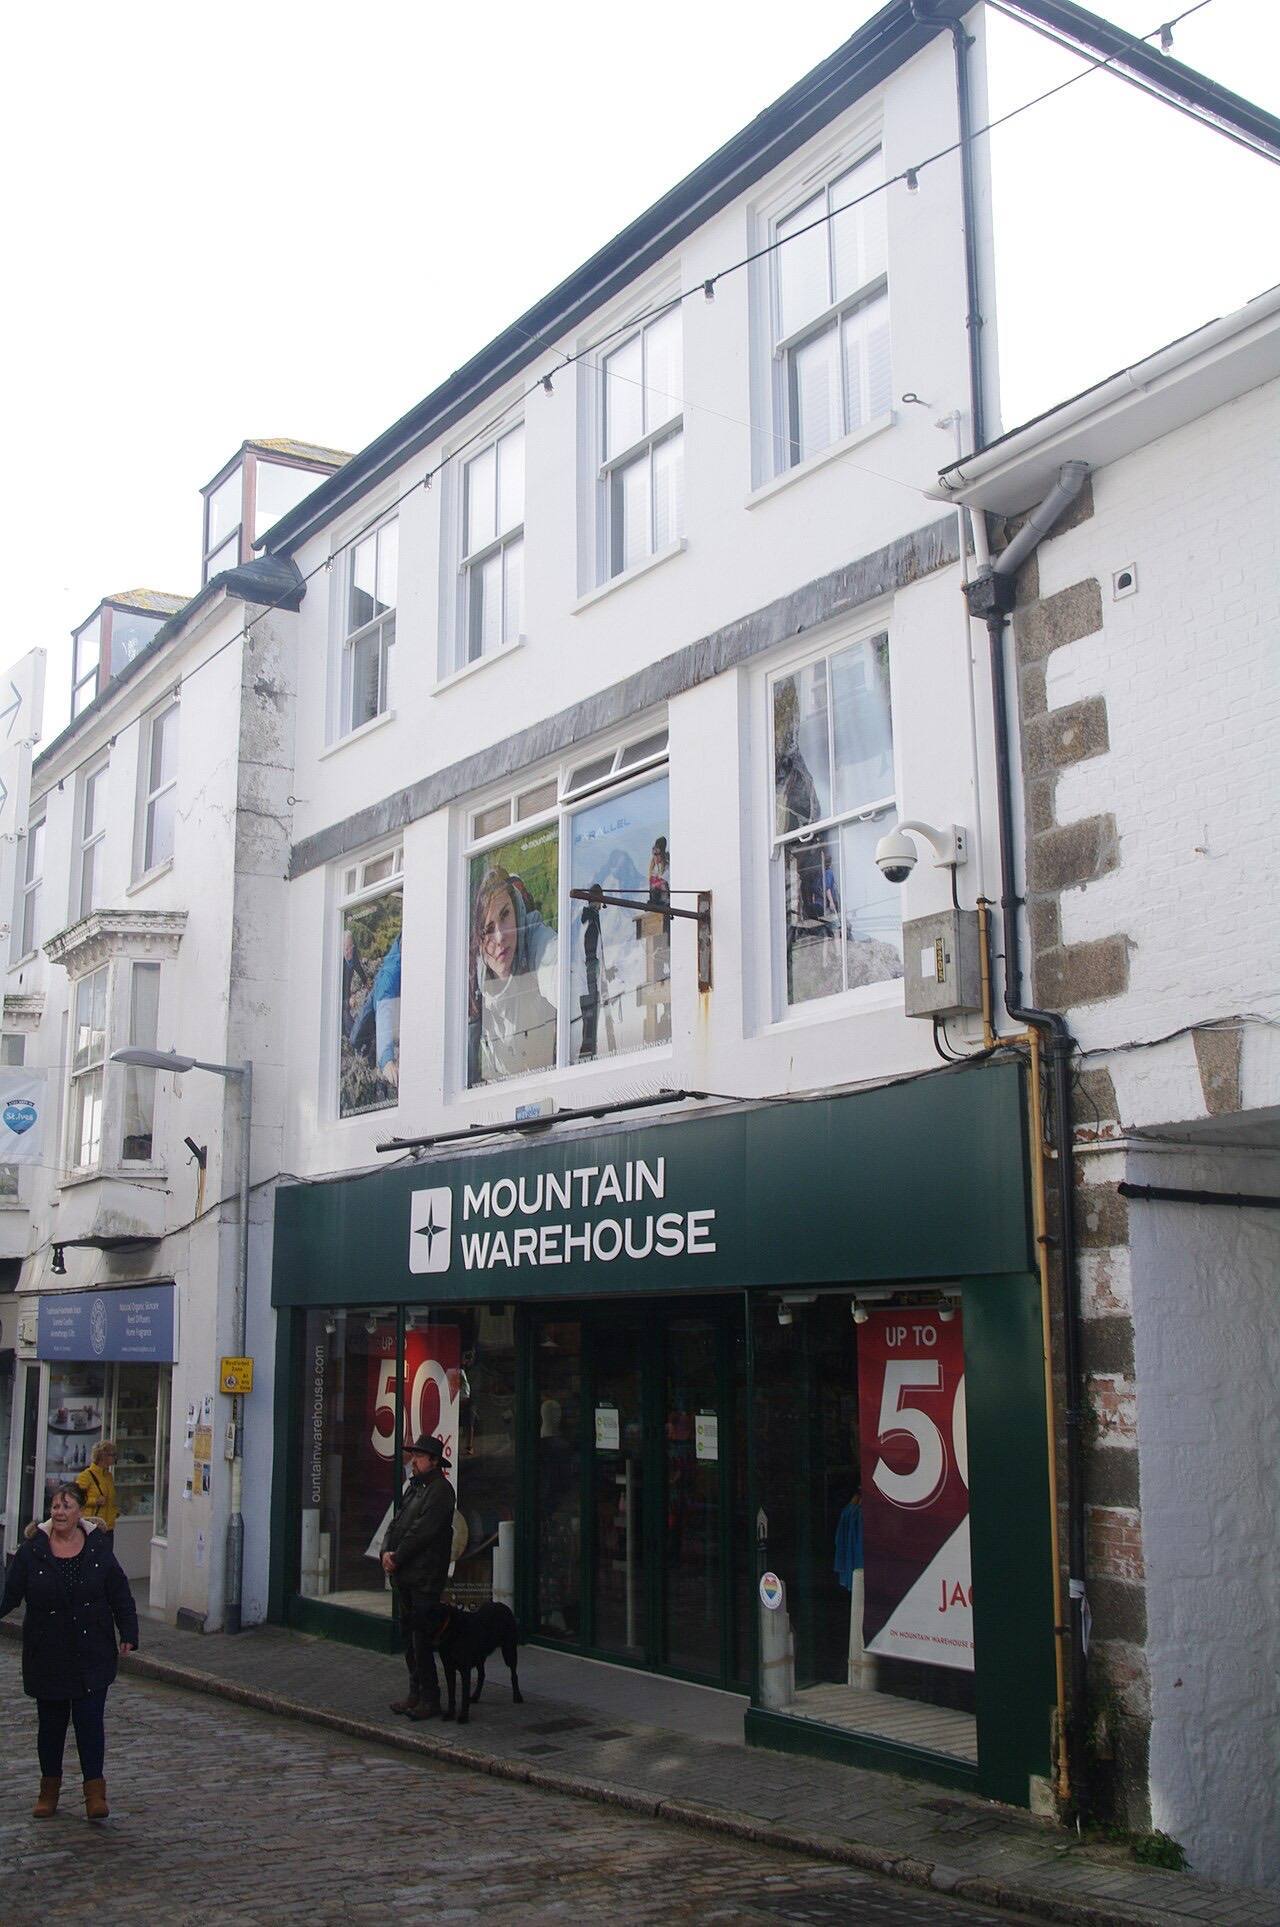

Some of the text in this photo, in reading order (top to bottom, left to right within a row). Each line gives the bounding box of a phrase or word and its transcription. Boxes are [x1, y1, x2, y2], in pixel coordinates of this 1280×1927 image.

[463, 1156, 666, 1220] MOUNTAIN
[460, 1210, 717, 1270] WAREHOUSE
[382, 1336, 393, 1350] UP
[885, 1325, 937, 1347] UP TO
[872, 1359, 969, 1510] 5
[900, 1631, 930, 1642] MOUNTAIN
[931, 1635, 969, 1648] WAREHOUSE
